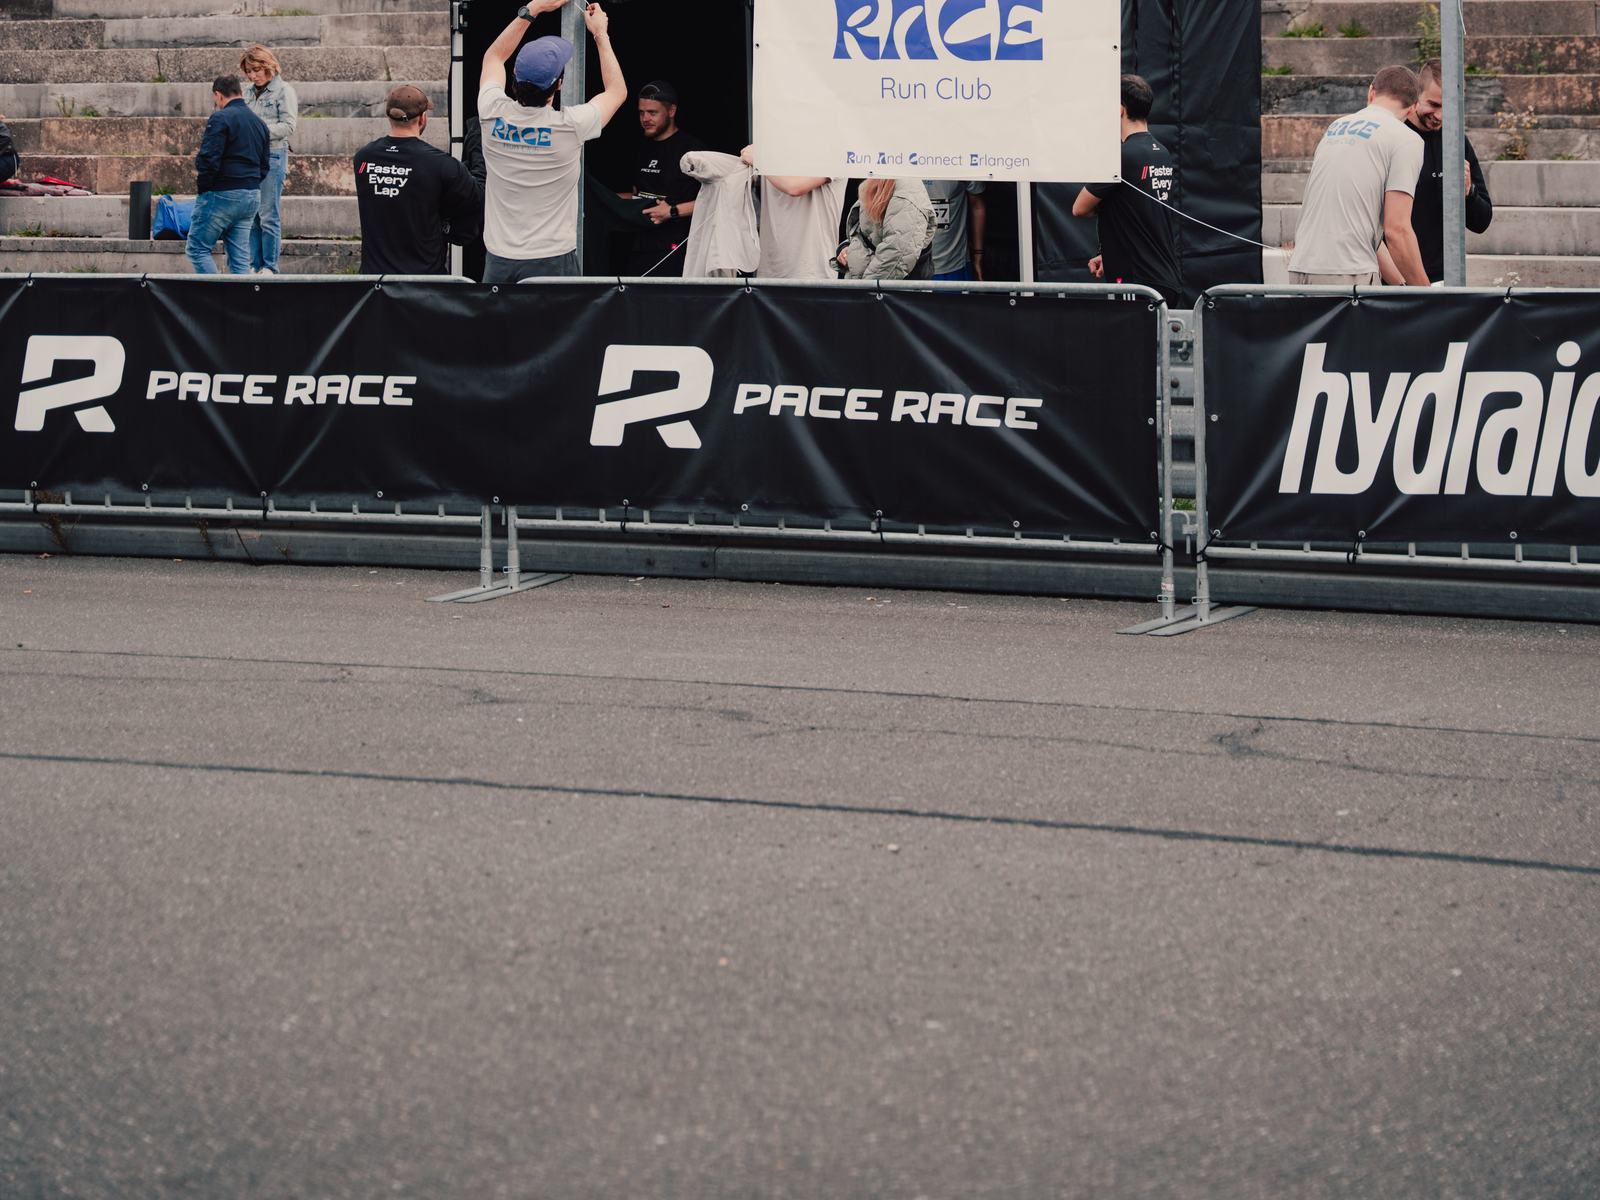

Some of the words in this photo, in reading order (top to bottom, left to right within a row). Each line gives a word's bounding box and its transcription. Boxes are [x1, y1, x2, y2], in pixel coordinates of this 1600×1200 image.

[881, 77, 926, 99] Run
[936, 77, 992, 100] Club
[846, 151, 871, 165] Run
[877, 152, 903, 166] And
[908, 152, 962, 166] Connect
[969, 153, 1030, 169] Erlangen
[369, 173, 408, 187] Every
[1151, 177, 1172, 191] Every
[374, 184, 399, 197] Lap
[1156, 189, 1169, 201] La
[15, 335, 126, 433] R
[146, 370, 277, 404] PACE
[284, 374, 417, 406] RACE
[589, 344, 714, 449] R
[733, 383, 883, 421] PACE
[890, 390, 1043, 430] RACE
